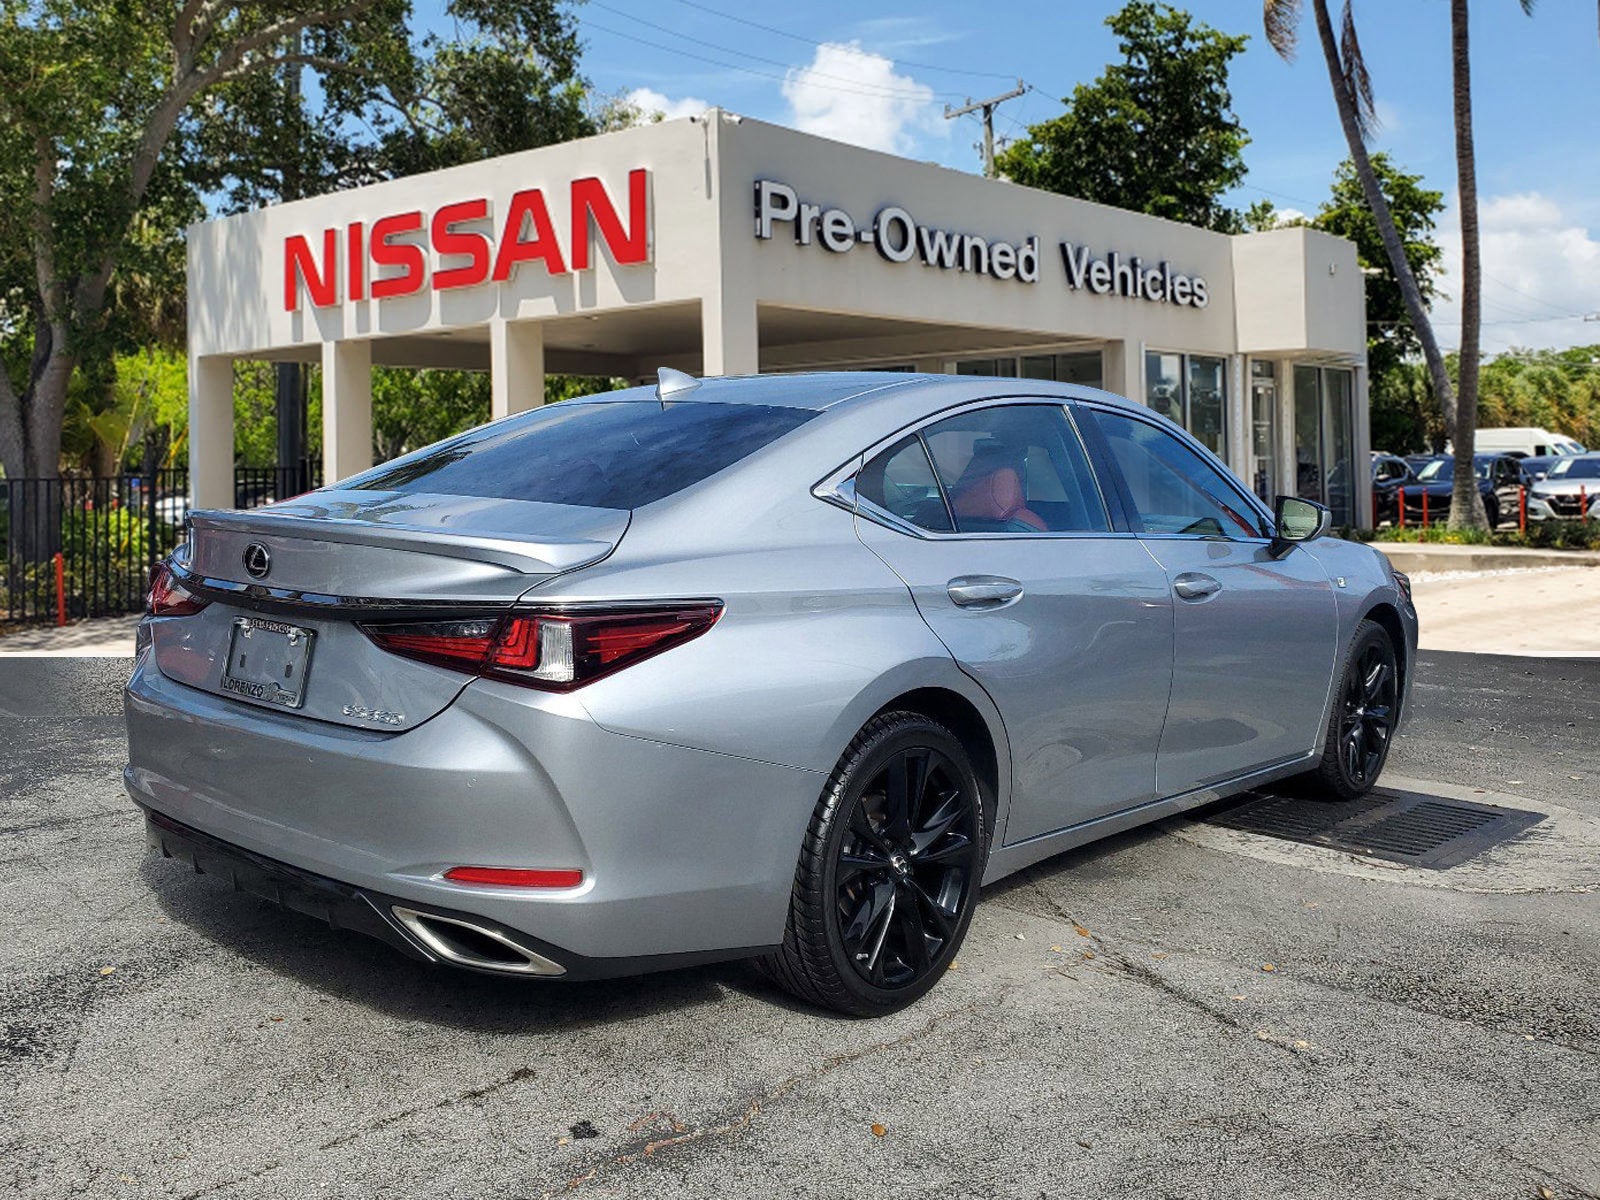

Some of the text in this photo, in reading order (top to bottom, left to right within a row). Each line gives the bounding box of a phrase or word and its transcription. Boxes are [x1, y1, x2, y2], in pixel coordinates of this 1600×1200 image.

[284, 167, 650, 312] NISSAN
[754, 179, 1209, 309] Pre-Owned Vehicles
[223, 676, 264, 698] LORENZO
